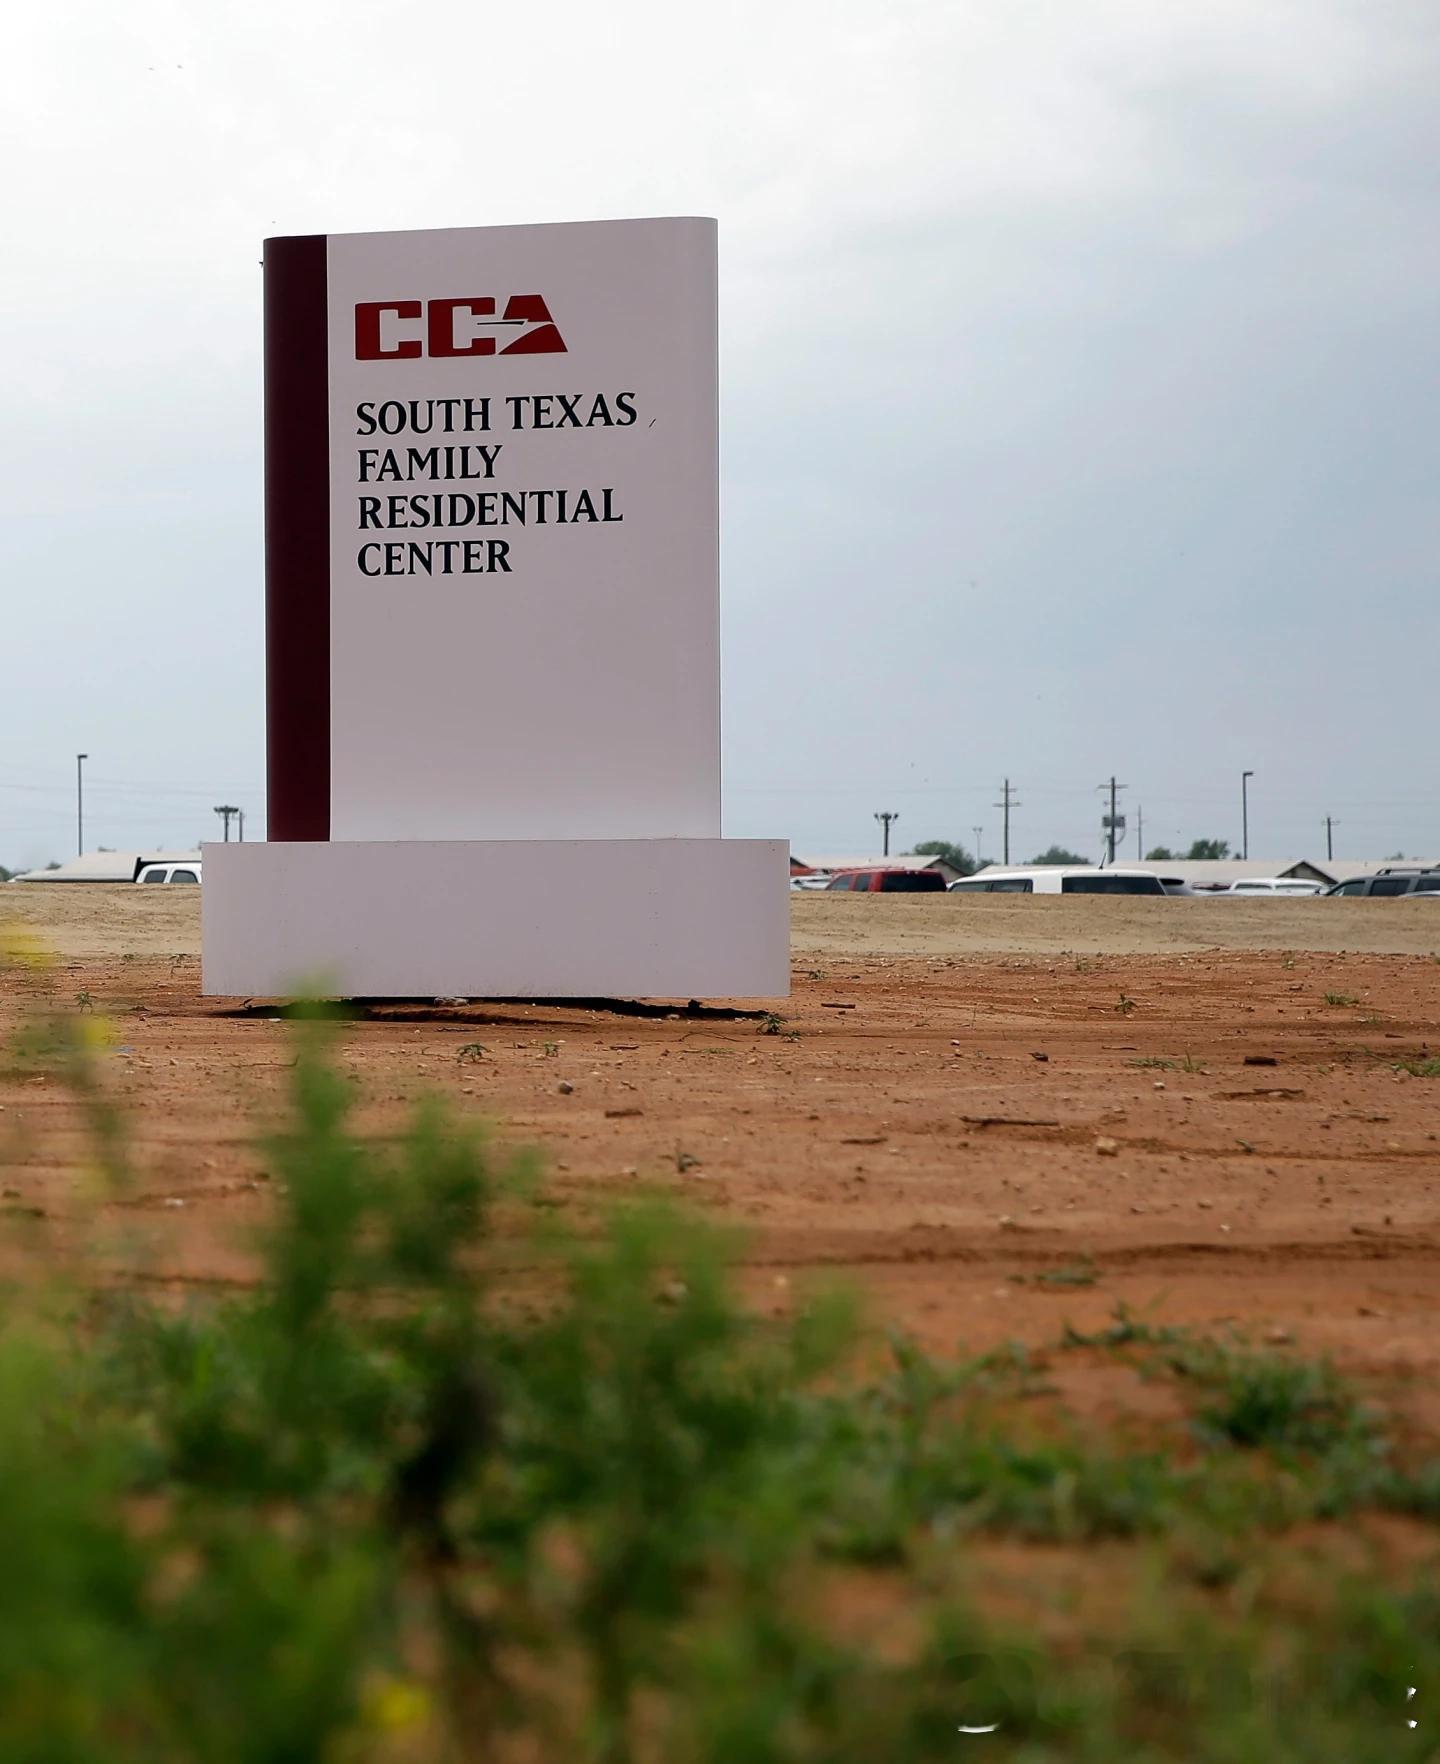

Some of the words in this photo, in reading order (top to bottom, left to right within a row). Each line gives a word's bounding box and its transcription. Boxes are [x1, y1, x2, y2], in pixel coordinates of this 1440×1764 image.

[355, 294, 568, 360] CCA
[356, 397, 491, 435] SOUTH
[506, 392, 638, 430] TEXAS
[357, 445, 503, 483] FAMILY
[358, 488, 624, 530] RESIDENTIAL
[357, 539, 513, 577] CENTER
